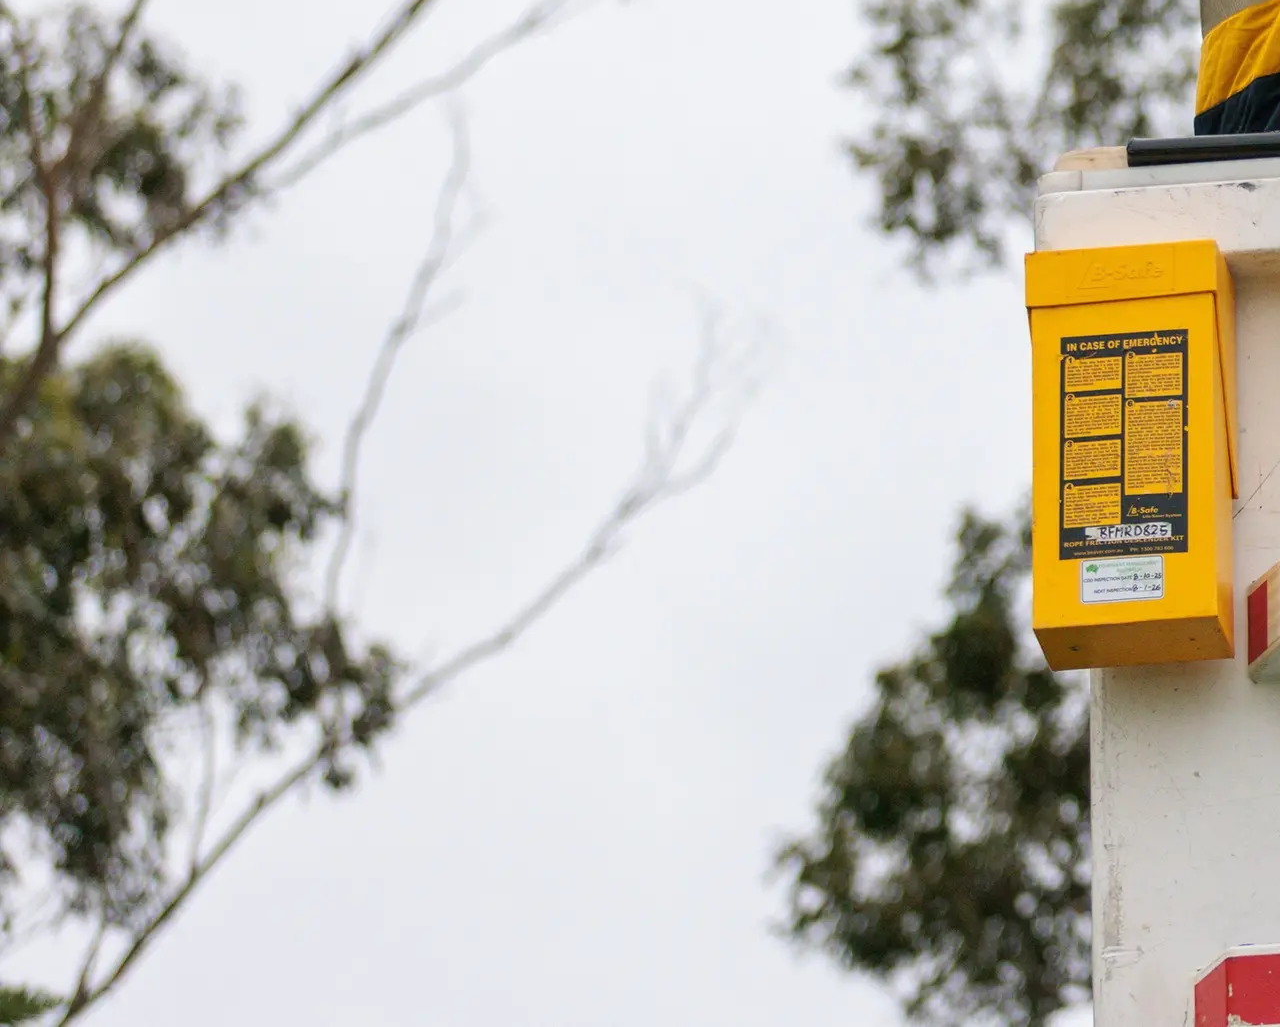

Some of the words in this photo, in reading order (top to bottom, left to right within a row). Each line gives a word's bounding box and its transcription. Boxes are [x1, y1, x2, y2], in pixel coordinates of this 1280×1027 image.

[1067, 343, 1077, 352] IN
[1080, 341, 1105, 351] CASE
[1108, 340, 1120, 349] OF
[1123, 336, 1183, 349] EMERGENCY
[1131, 505, 1159, 514] B-Safe
